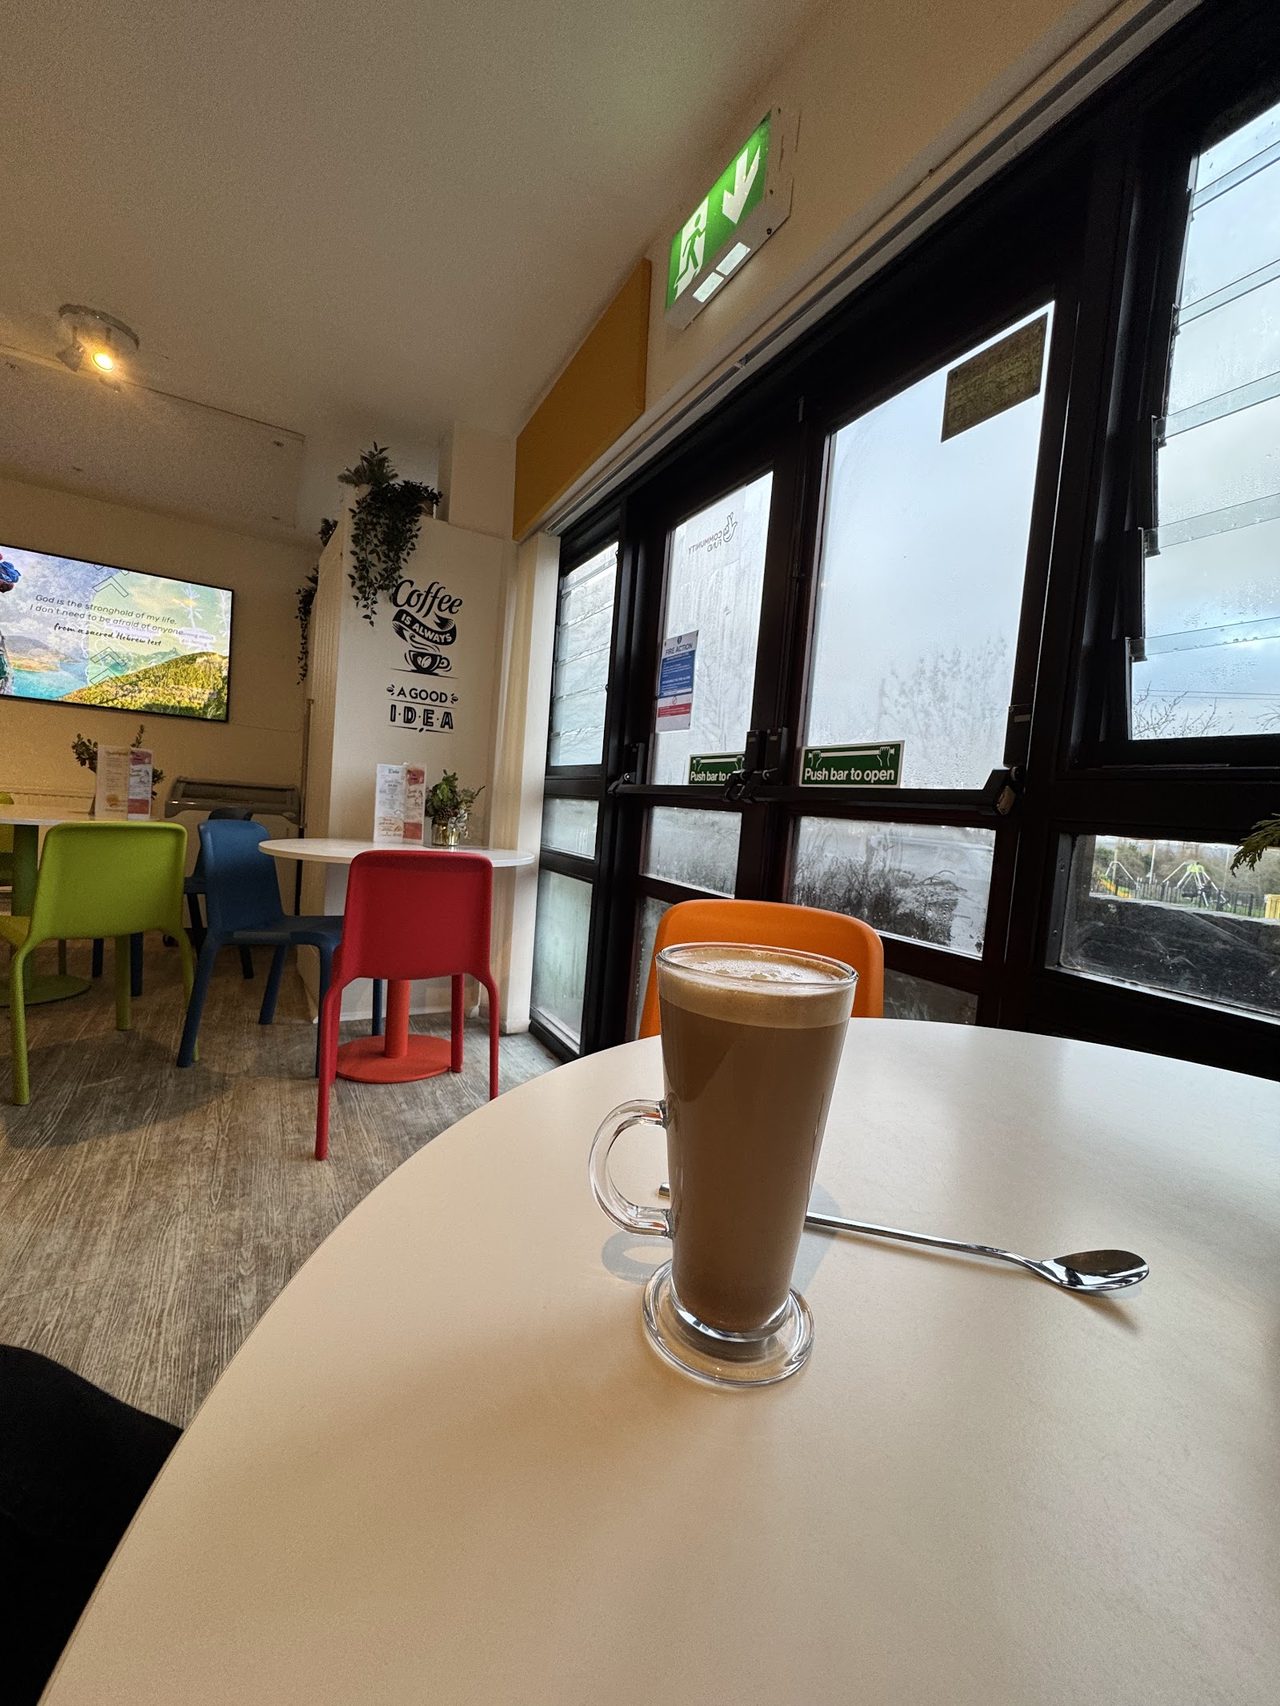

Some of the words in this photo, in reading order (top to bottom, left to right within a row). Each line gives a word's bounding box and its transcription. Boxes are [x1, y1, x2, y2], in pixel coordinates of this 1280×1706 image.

[35, 594, 55, 604] God
[67, 600, 82, 608] the
[85, 603, 134, 617] stronghold
[135, 611, 145, 619] of
[146, 614, 160, 622] my
[162, 616, 177, 625] life.
[392, 579, 463, 618] Coffee
[35, 604, 60, 615] don't
[61, 609, 85, 619] need
[88, 613, 97, 621] to
[99, 615, 111, 624] be
[112, 619, 139, 628] afraid
[141, 622, 150, 630] of
[401, 613, 412, 625] IS
[412, 623, 452, 643] ALWAYS
[54, 622, 76, 633] from
[85, 628, 114, 638] sacred
[115, 631, 146, 643] Hebrew
[147, 638, 162, 646] text
[675, 643, 693, 653] ACTION
[397, 686, 407, 698] A
[409, 688, 448, 703] GOOD
[690, 771, 706, 781] Push
[706, 771, 718, 781] bar
[718, 771, 727, 781] to
[804, 767, 829, 781] Push
[830, 767, 849, 781] bar
[850, 767, 862, 780] to
[863, 769, 895, 784] open
